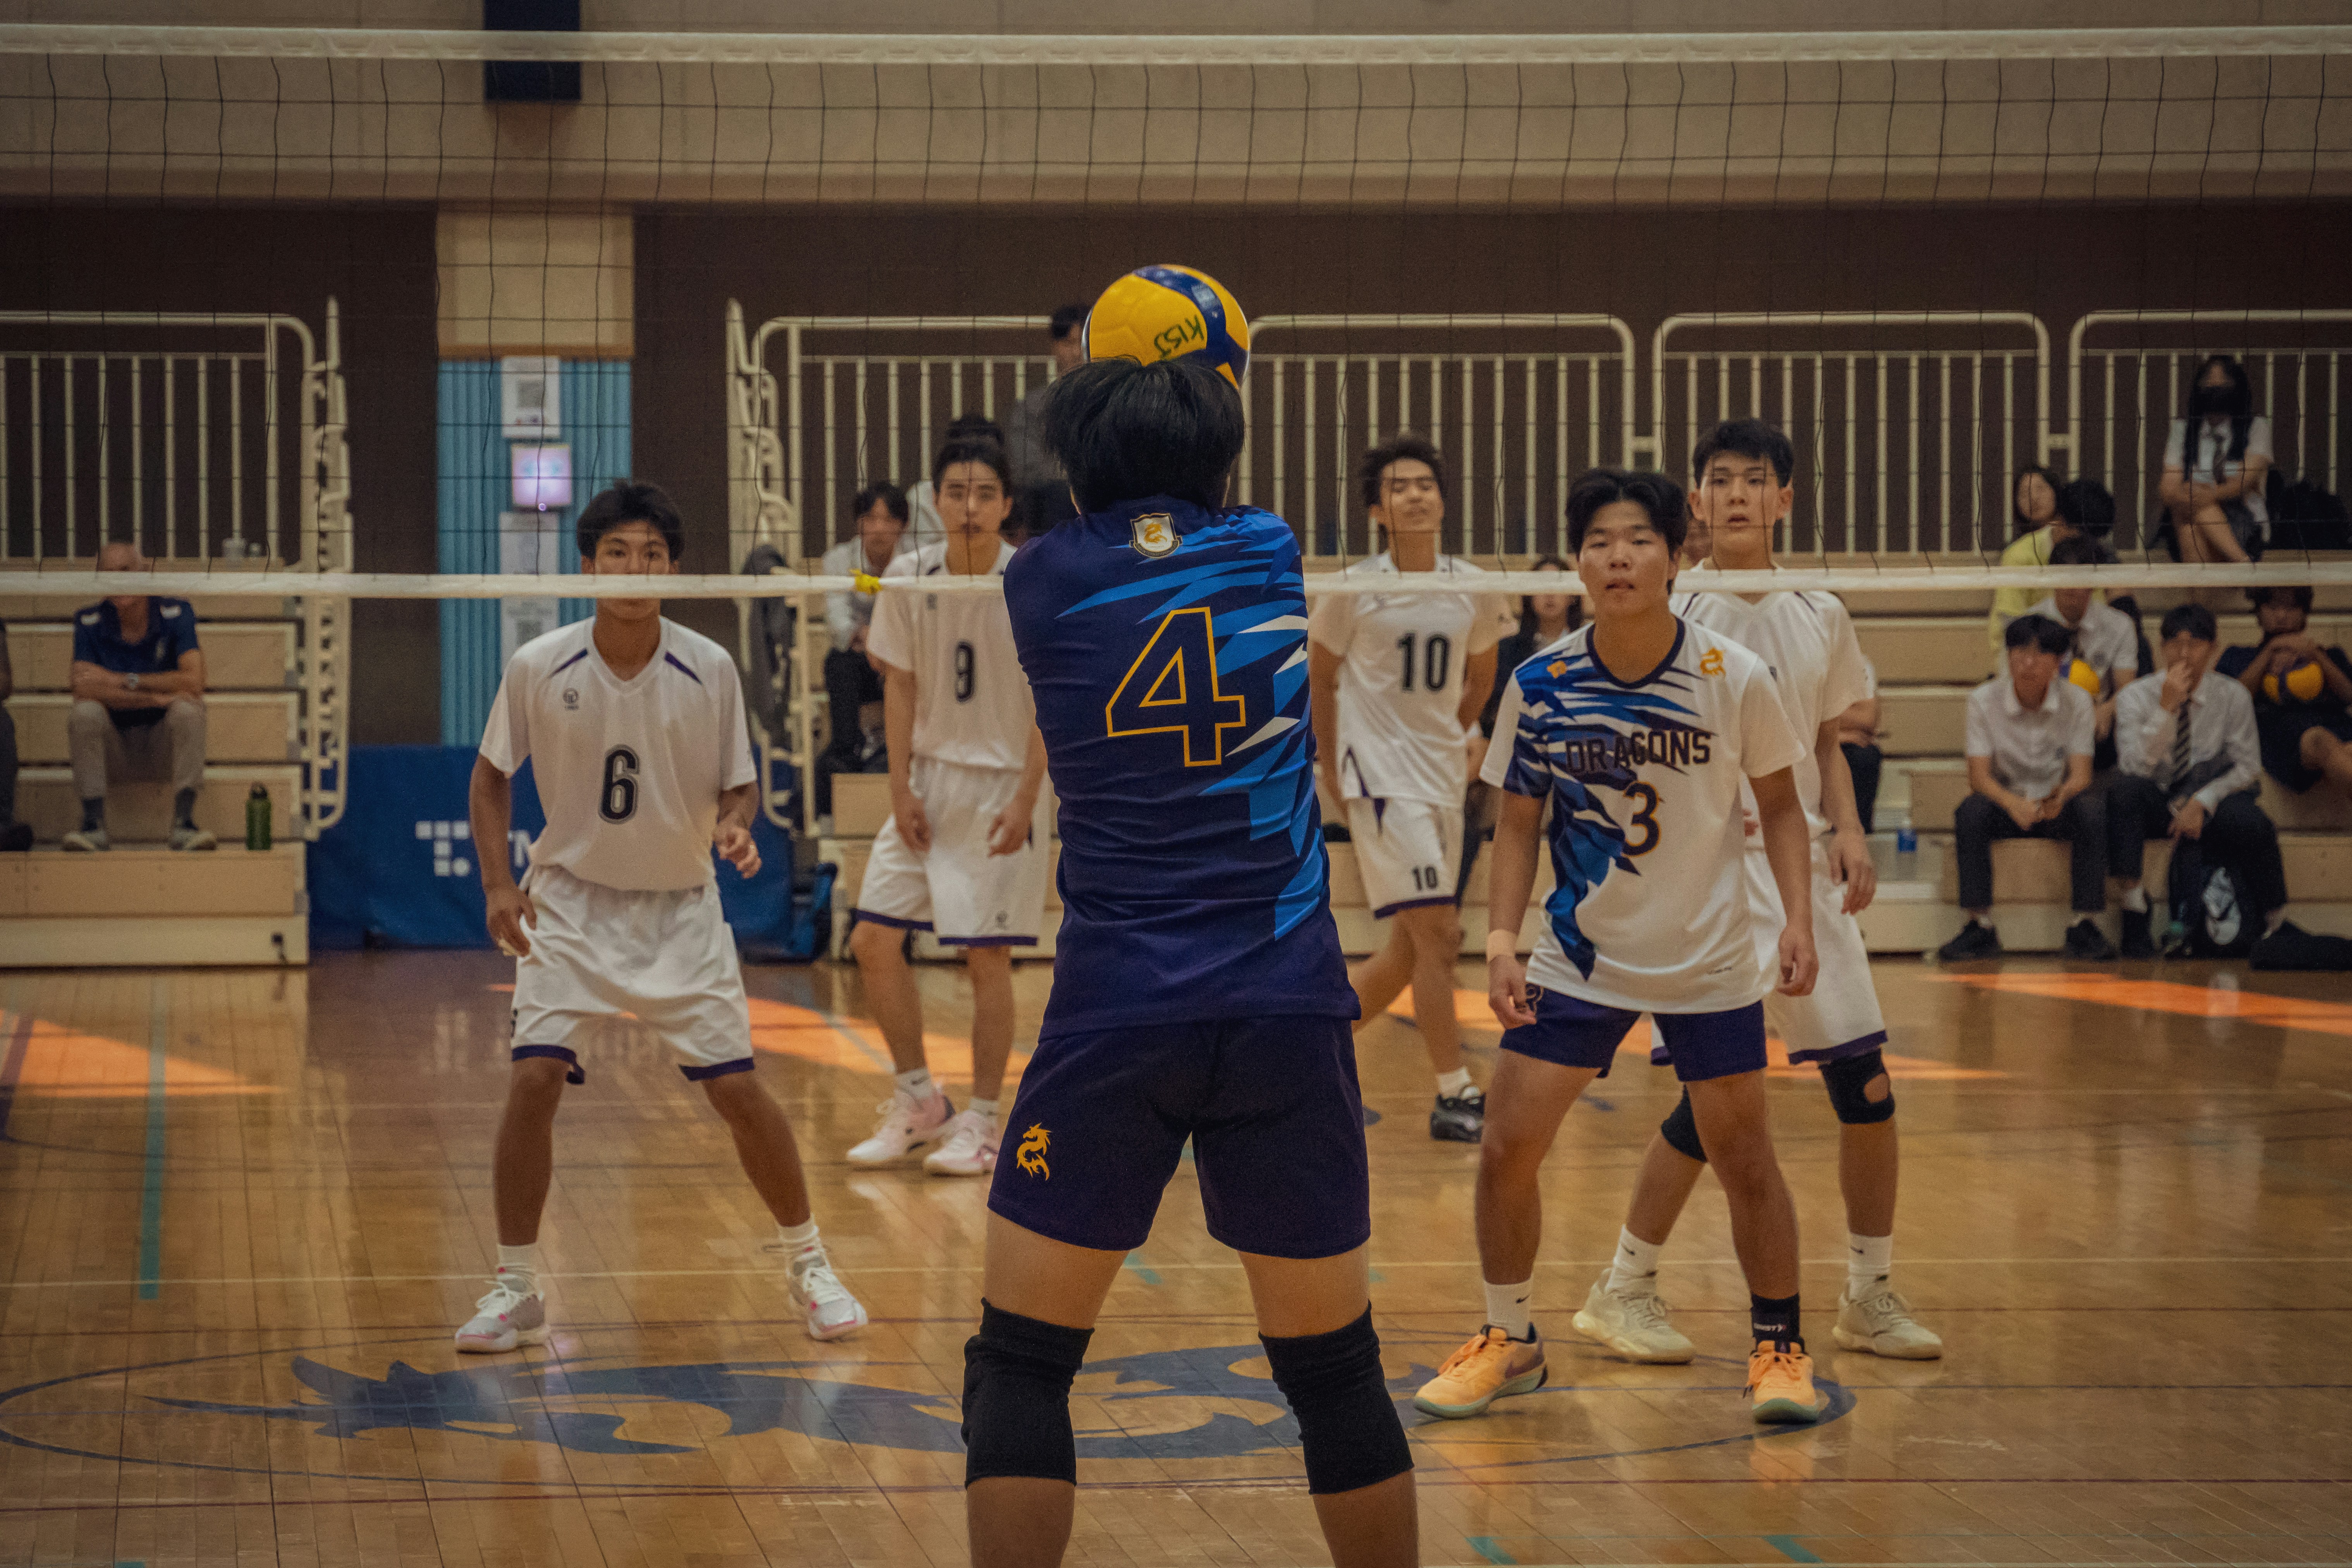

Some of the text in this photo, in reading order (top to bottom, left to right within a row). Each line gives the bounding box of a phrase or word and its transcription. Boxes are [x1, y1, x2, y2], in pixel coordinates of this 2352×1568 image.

[1154, 314, 1204, 359] KISJ
[954, 641, 977, 703] 9
[1105, 606, 1246, 767] 4
[1396, 631, 1451, 693] 10
[1565, 730, 1711, 773] DRAGONS
[598, 744, 641, 825] 6
[1620, 781, 1661, 858] 3
[1412, 866, 1438, 891] 10
